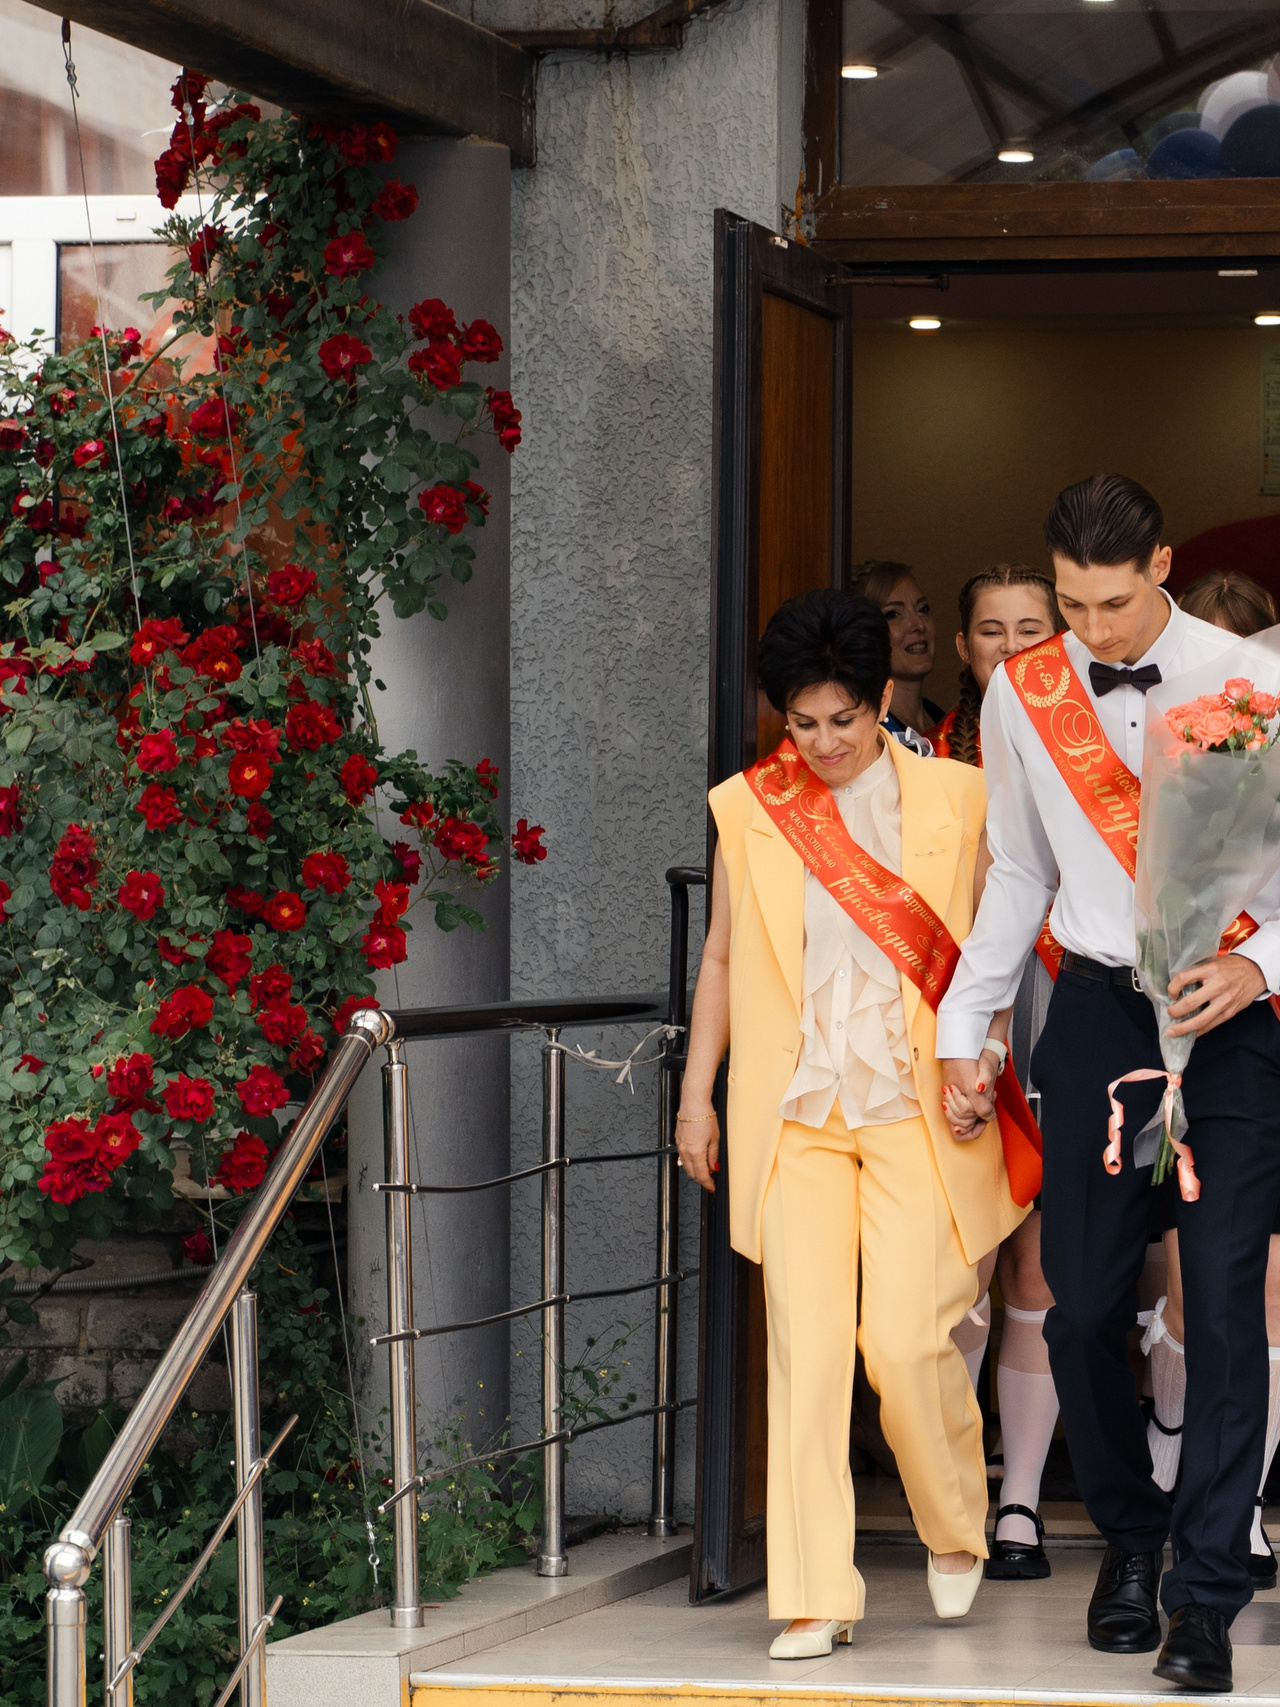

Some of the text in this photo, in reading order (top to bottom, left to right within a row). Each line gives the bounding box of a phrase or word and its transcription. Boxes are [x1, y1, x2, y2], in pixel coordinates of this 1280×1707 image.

[1050, 698, 1138, 852] Выпус
[1110, 767, 1141, 810] Недел
[784, 823, 822, 875] Новороссийск
[787, 808, 837, 869] МАОУ СОШ №40
[855, 853, 900, 889] Светлана
[826, 876, 938, 992] руководитель
[898, 886, 944, 938] Гарриевна
